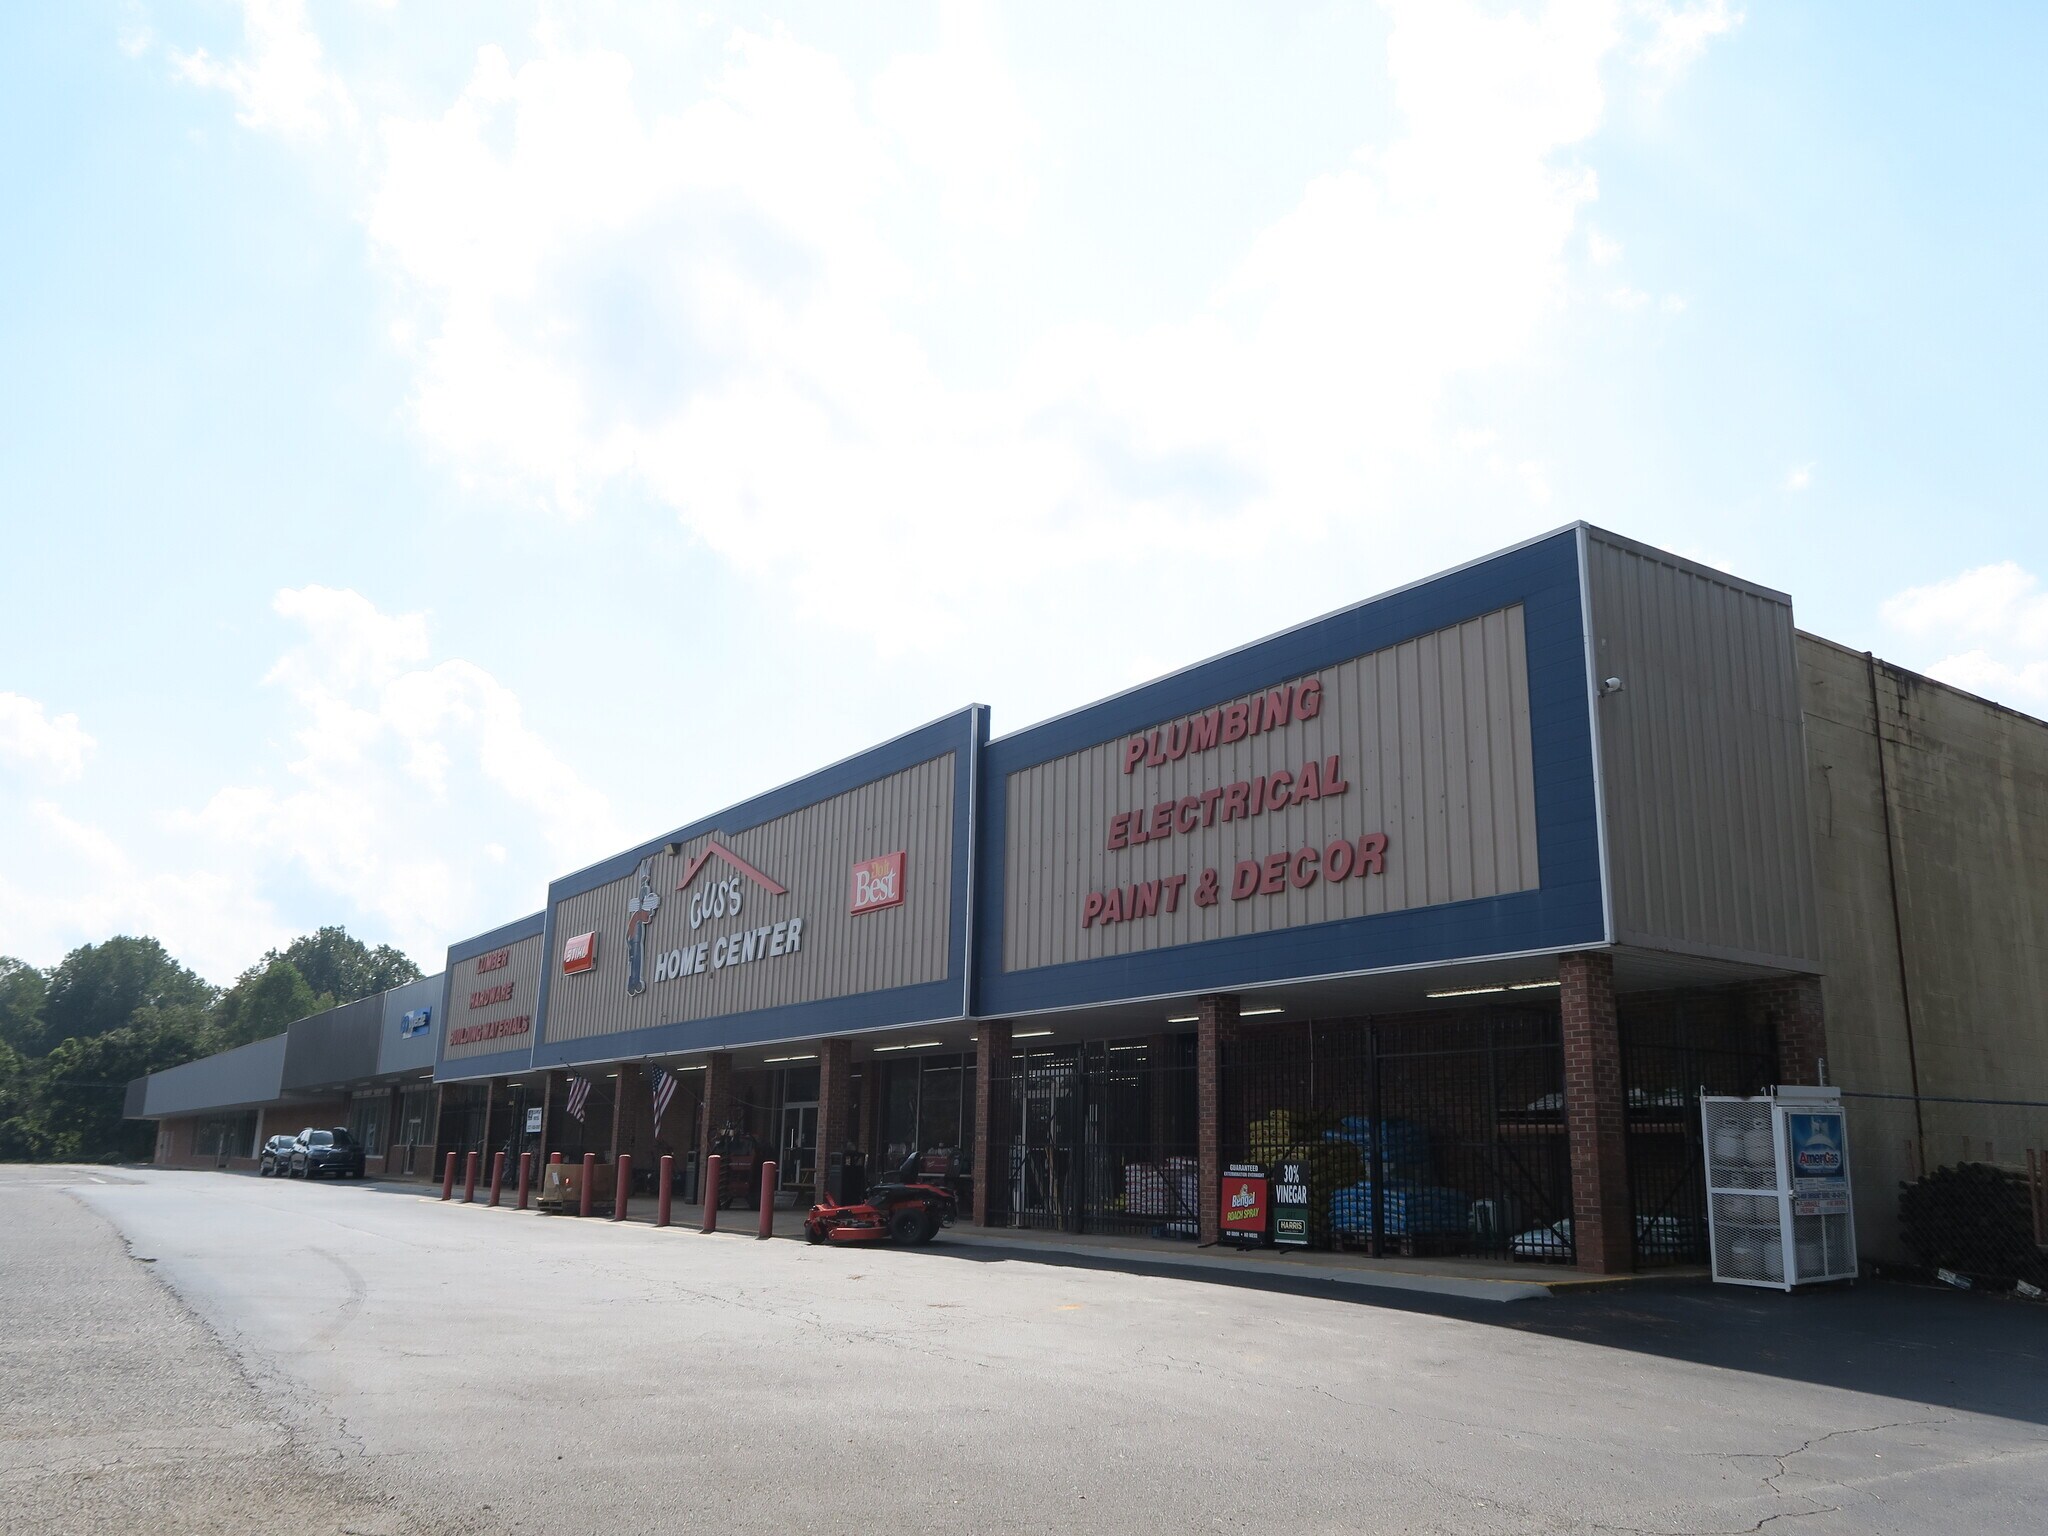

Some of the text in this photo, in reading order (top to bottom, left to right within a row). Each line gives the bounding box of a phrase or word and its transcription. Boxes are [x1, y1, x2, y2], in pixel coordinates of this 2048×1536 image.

[1124, 679, 1322, 774] PLUMBING
[1107, 755, 1348, 850] ELECTRICAL
[855, 868, 897, 907] Best
[1082, 832, 1389, 928] PAINT & DECOR
[690, 873, 743, 930] GUS'S
[477, 951, 509, 975] LUMBER
[654, 917, 804, 983] HOME CENTER
[469, 982, 514, 1009] HARDWARE
[450, 1015, 530, 1046] BUILDING MATERIALS
[1800, 1152, 1838, 1165] AmeriGas
[1284, 1165, 1299, 1183] 30%
[1232, 1192, 1255, 1207] Bengal
[1276, 1185, 1307, 1204] VINEGAR
[1226, 1207, 1260, 1222] ROACH SPRAY
[1281, 1221, 1302, 1230] HARRIS
